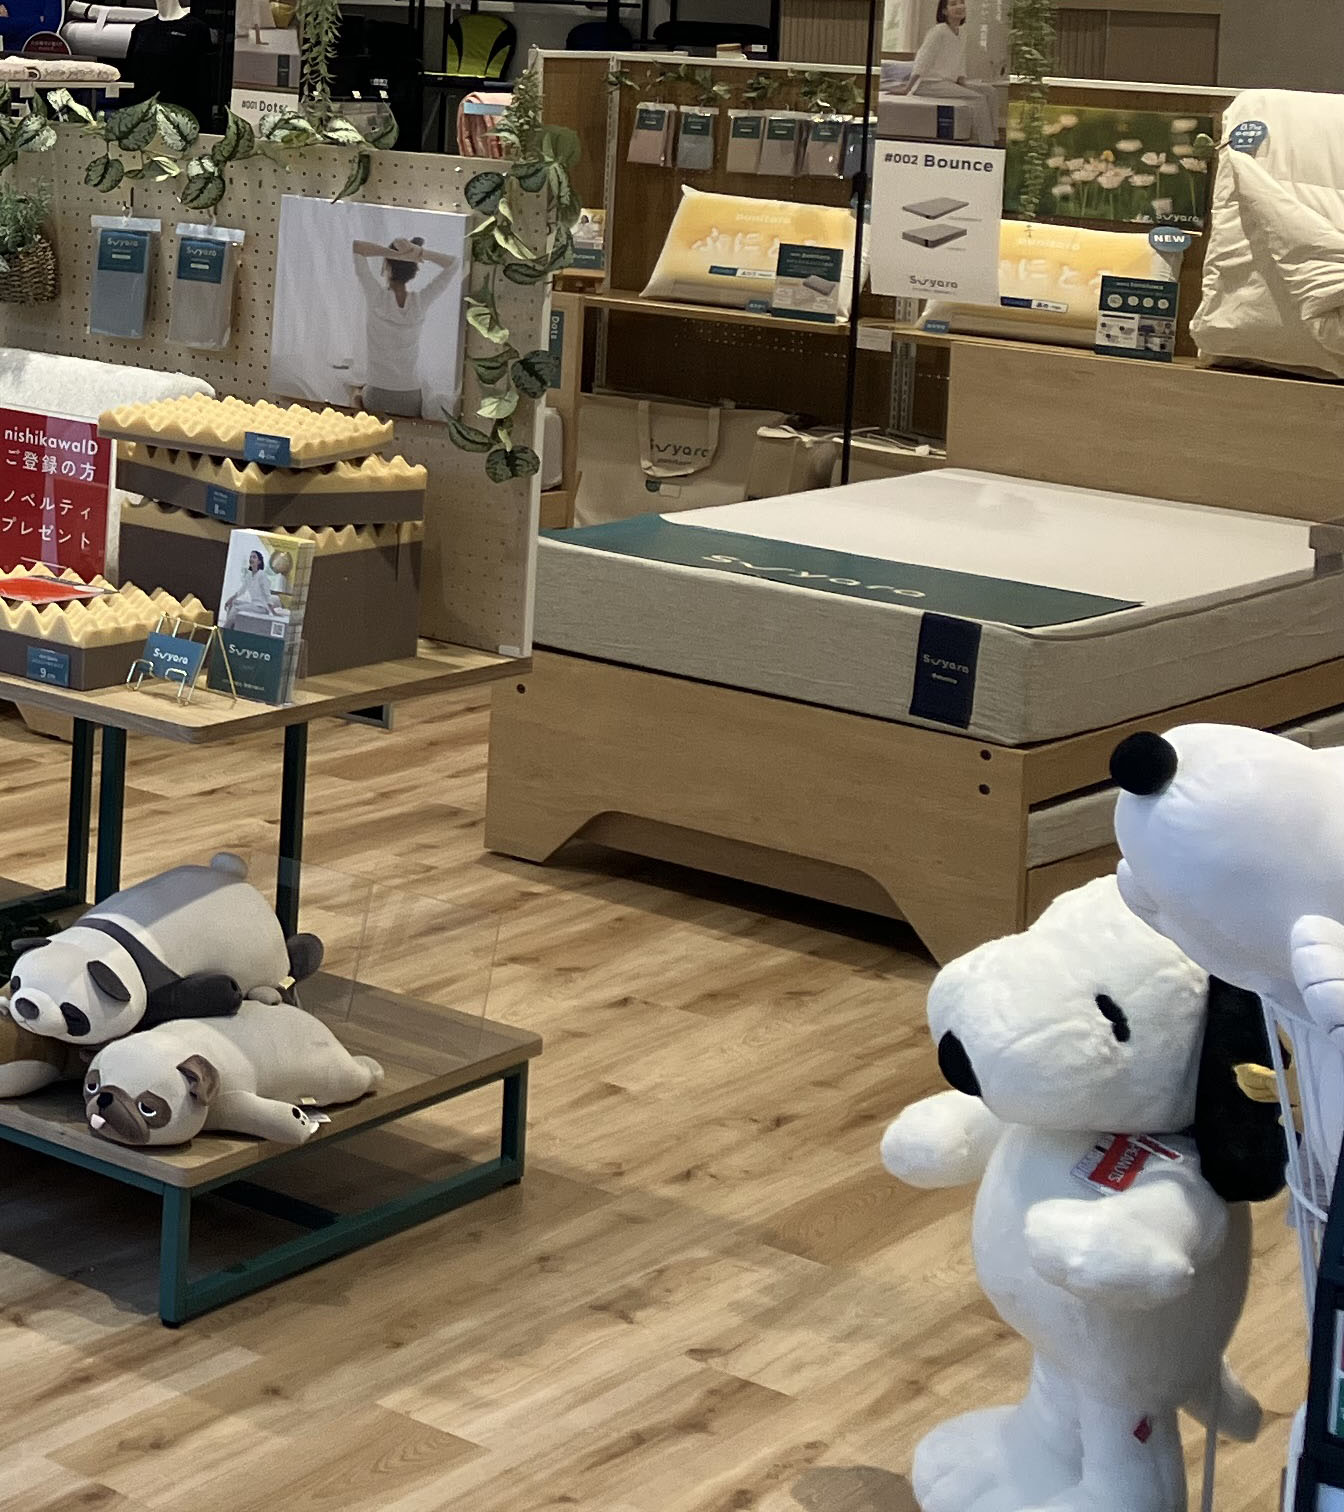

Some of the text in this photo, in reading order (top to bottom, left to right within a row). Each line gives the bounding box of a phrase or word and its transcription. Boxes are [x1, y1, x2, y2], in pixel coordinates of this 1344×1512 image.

[885, 152, 993, 173] #002 Bounce
[1153, 234, 1185, 243] NEW
[5, 426, 98, 455] nishikawaID
[6, 449, 96, 482] ご登録の方
[4, 490, 90, 520] ノベルティ
[2, 516, 90, 550] プレゼント
[153, 647, 189, 665] Suyara
[228, 644, 271, 662] Suyara
[923, 654, 969, 674] Suyara
